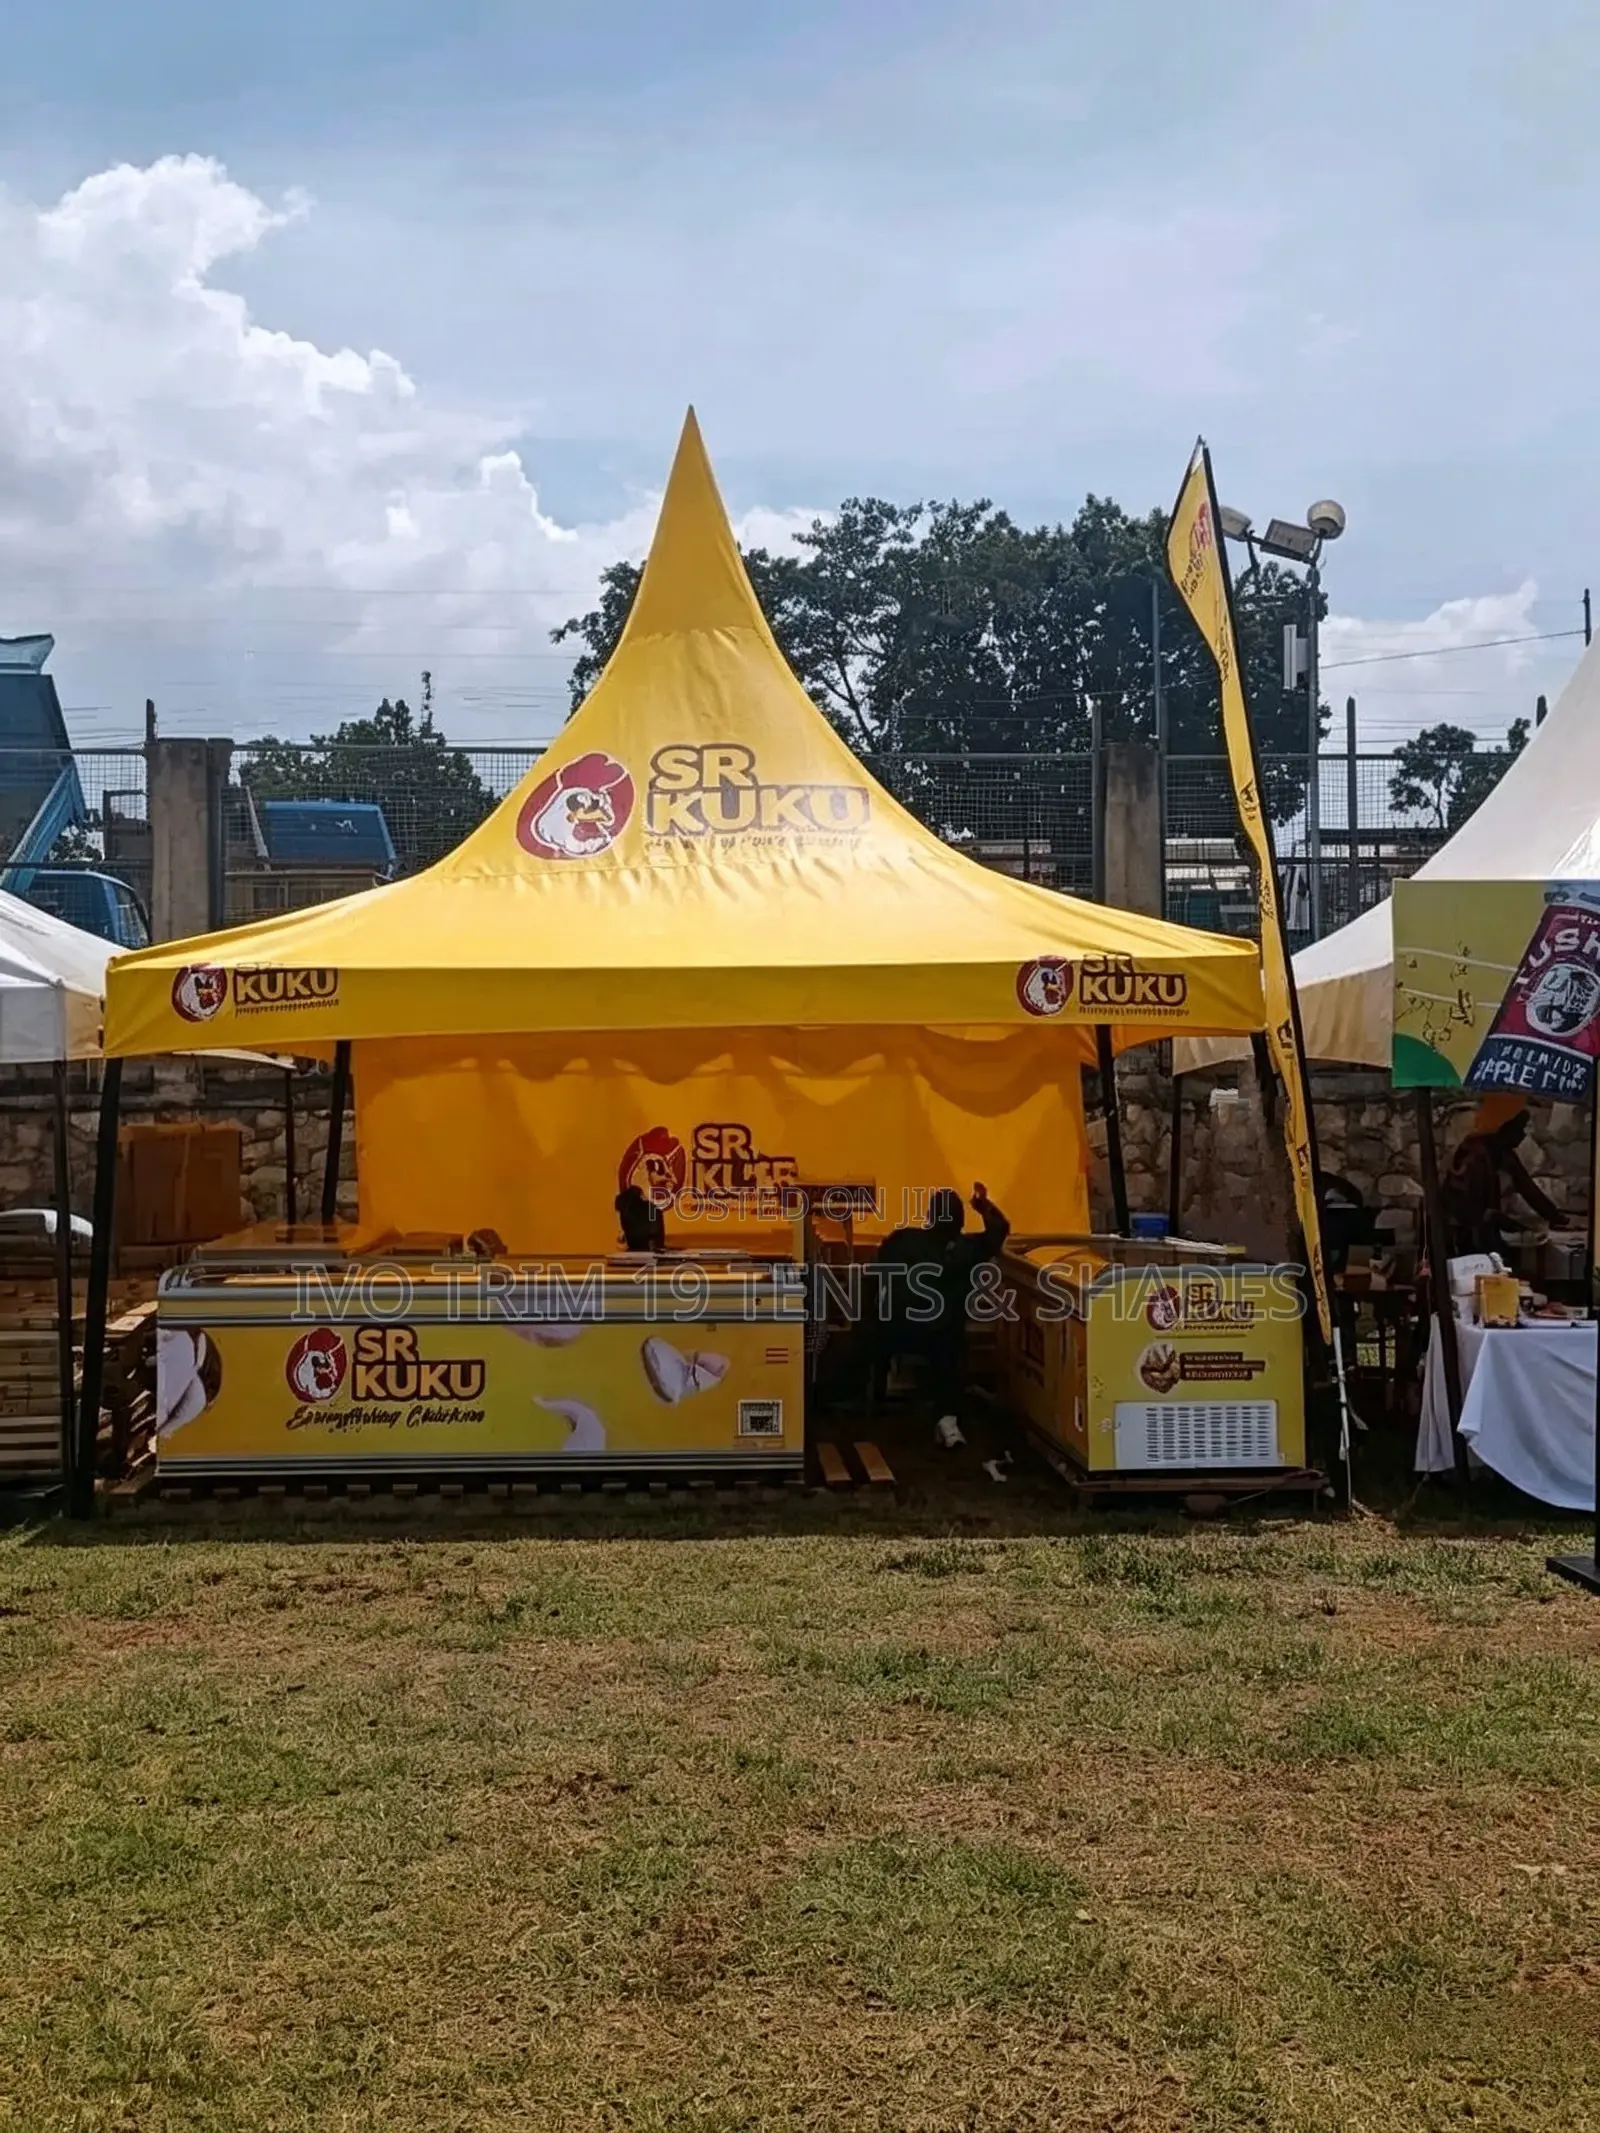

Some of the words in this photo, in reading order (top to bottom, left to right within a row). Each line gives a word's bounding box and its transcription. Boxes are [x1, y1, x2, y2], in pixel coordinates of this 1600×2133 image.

[651, 746, 754, 789] SR
[651, 787, 869, 834] KUKU
[236, 968, 336, 1003] KUKU
[1082, 974, 1185, 1004] KUKU
[695, 1126, 750, 1160] SR
[356, 1327, 417, 1362] SR
[355, 1363, 482, 1398] KUKU
